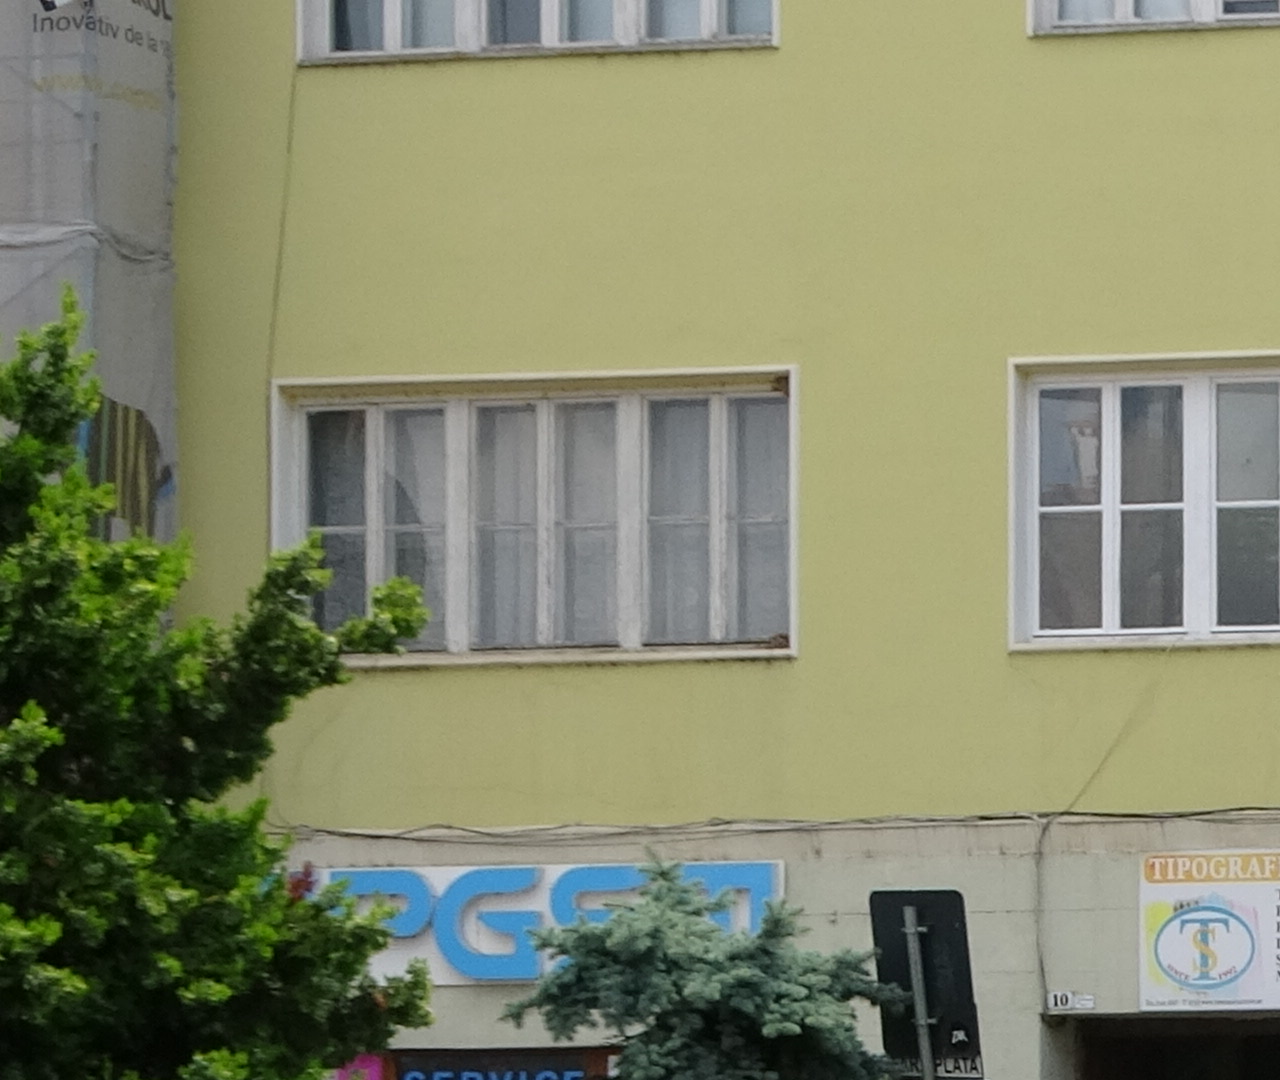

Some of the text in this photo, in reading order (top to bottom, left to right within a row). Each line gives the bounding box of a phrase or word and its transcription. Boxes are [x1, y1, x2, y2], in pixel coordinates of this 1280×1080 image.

[33, 13, 119, 39] Inovativ
[124, 25, 144, 46] de
[1053, 993, 1069, 1007] 10
